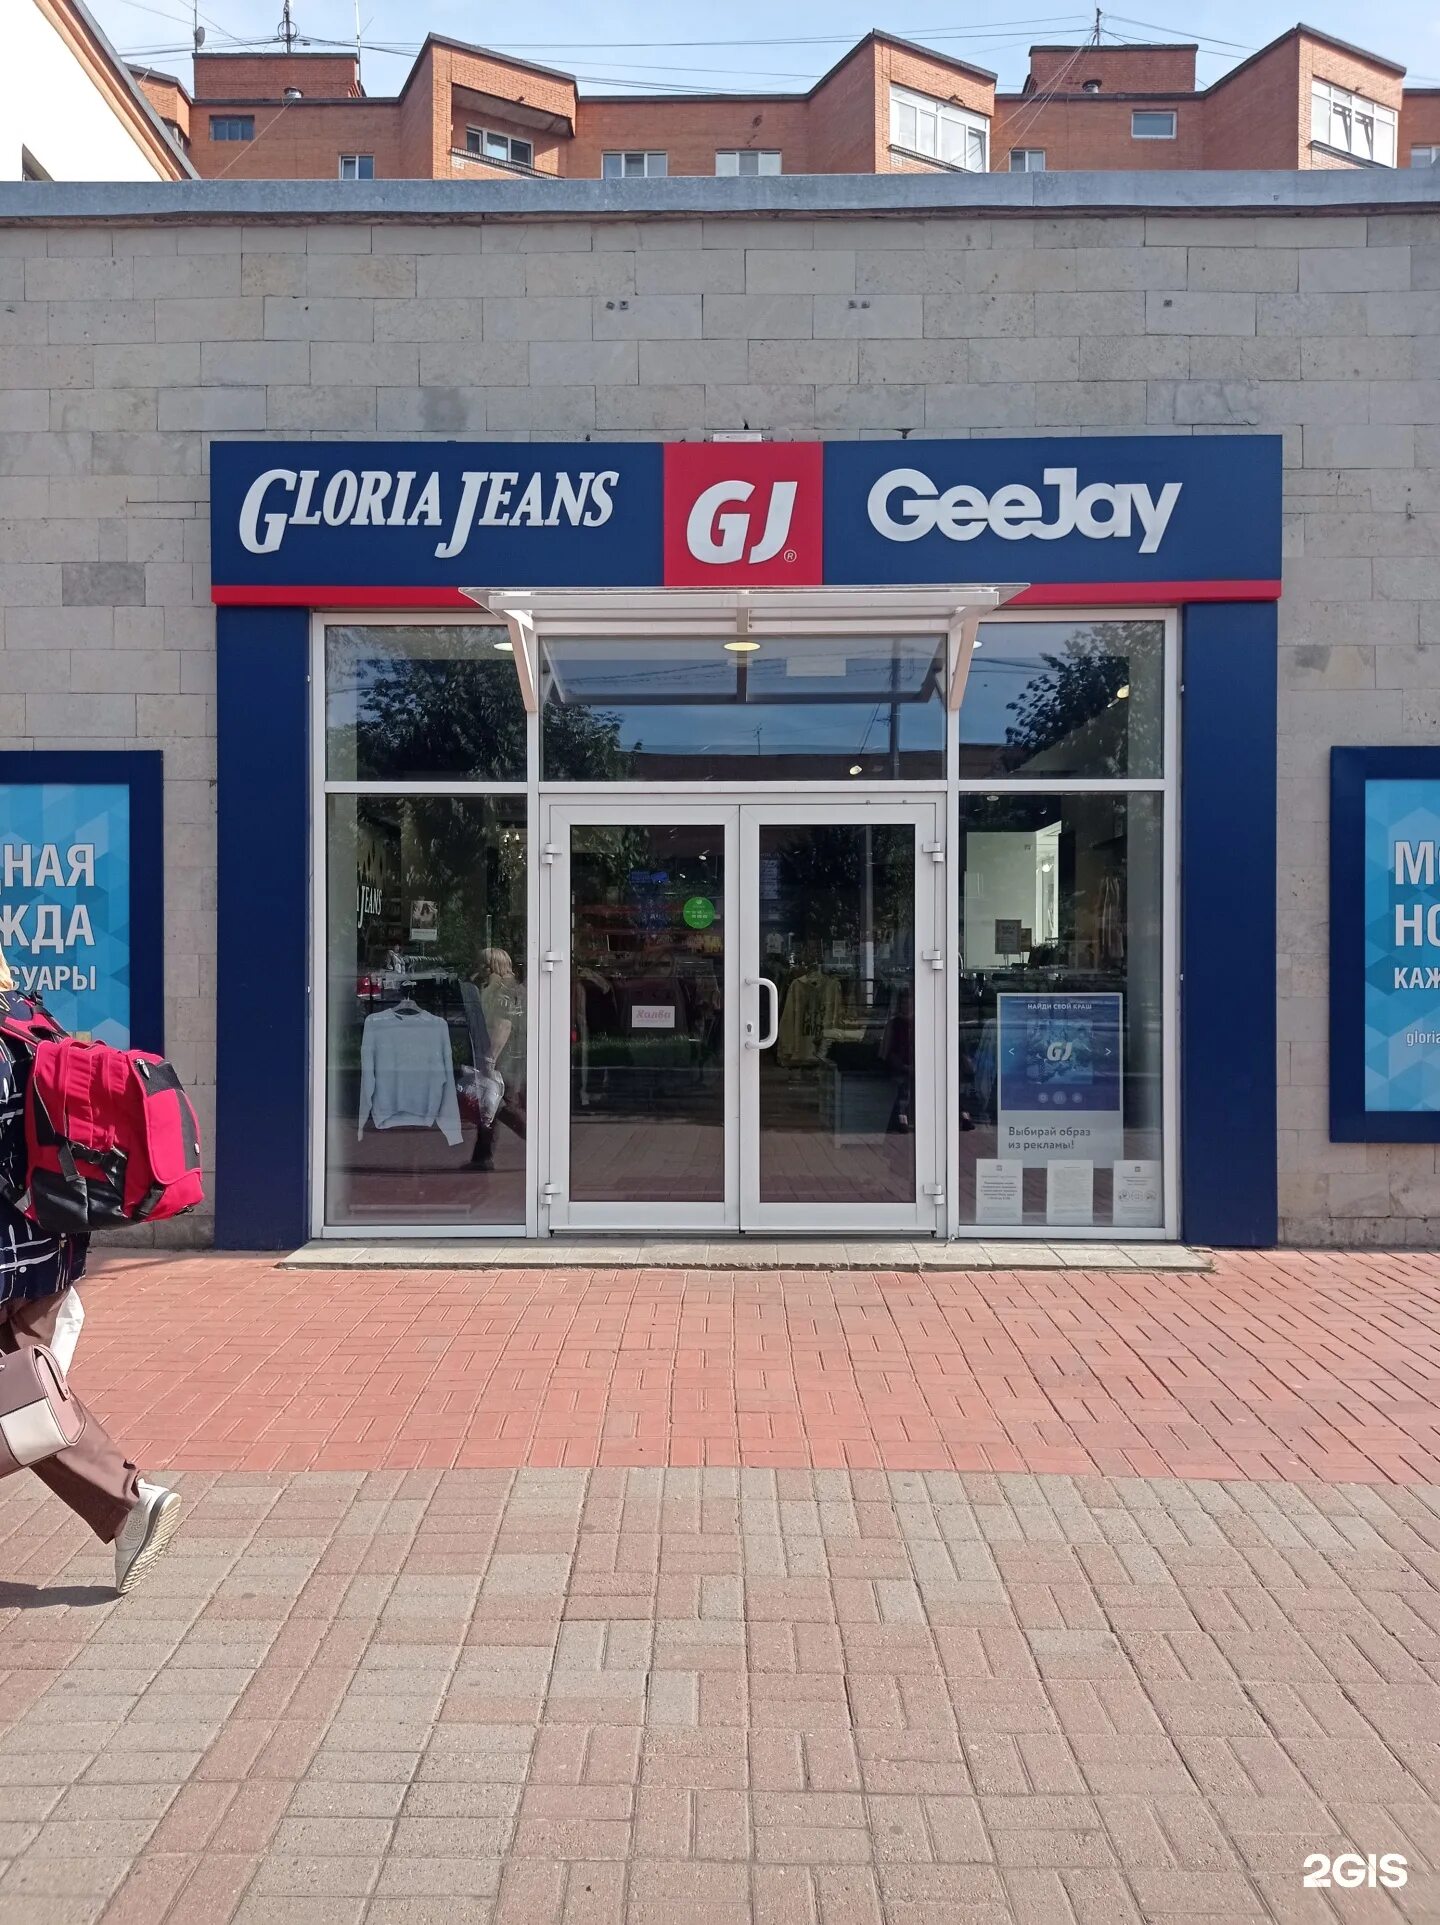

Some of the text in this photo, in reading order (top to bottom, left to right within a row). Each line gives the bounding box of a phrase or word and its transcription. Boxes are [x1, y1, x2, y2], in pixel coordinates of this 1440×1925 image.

[239, 468, 620, 559] GLORIA JEANS
[686, 480, 798, 564] GJ
[867, 467, 1183, 554] GeeJay
[0, 842, 96, 892] НАЯ
[1395, 841, 1440, 886] М
[1046, 1041, 1073, 1061] GJ
[1008, 1126, 1091, 1139] Выбирай образ
[1008, 1139, 1074, 1151] из рекламы!
